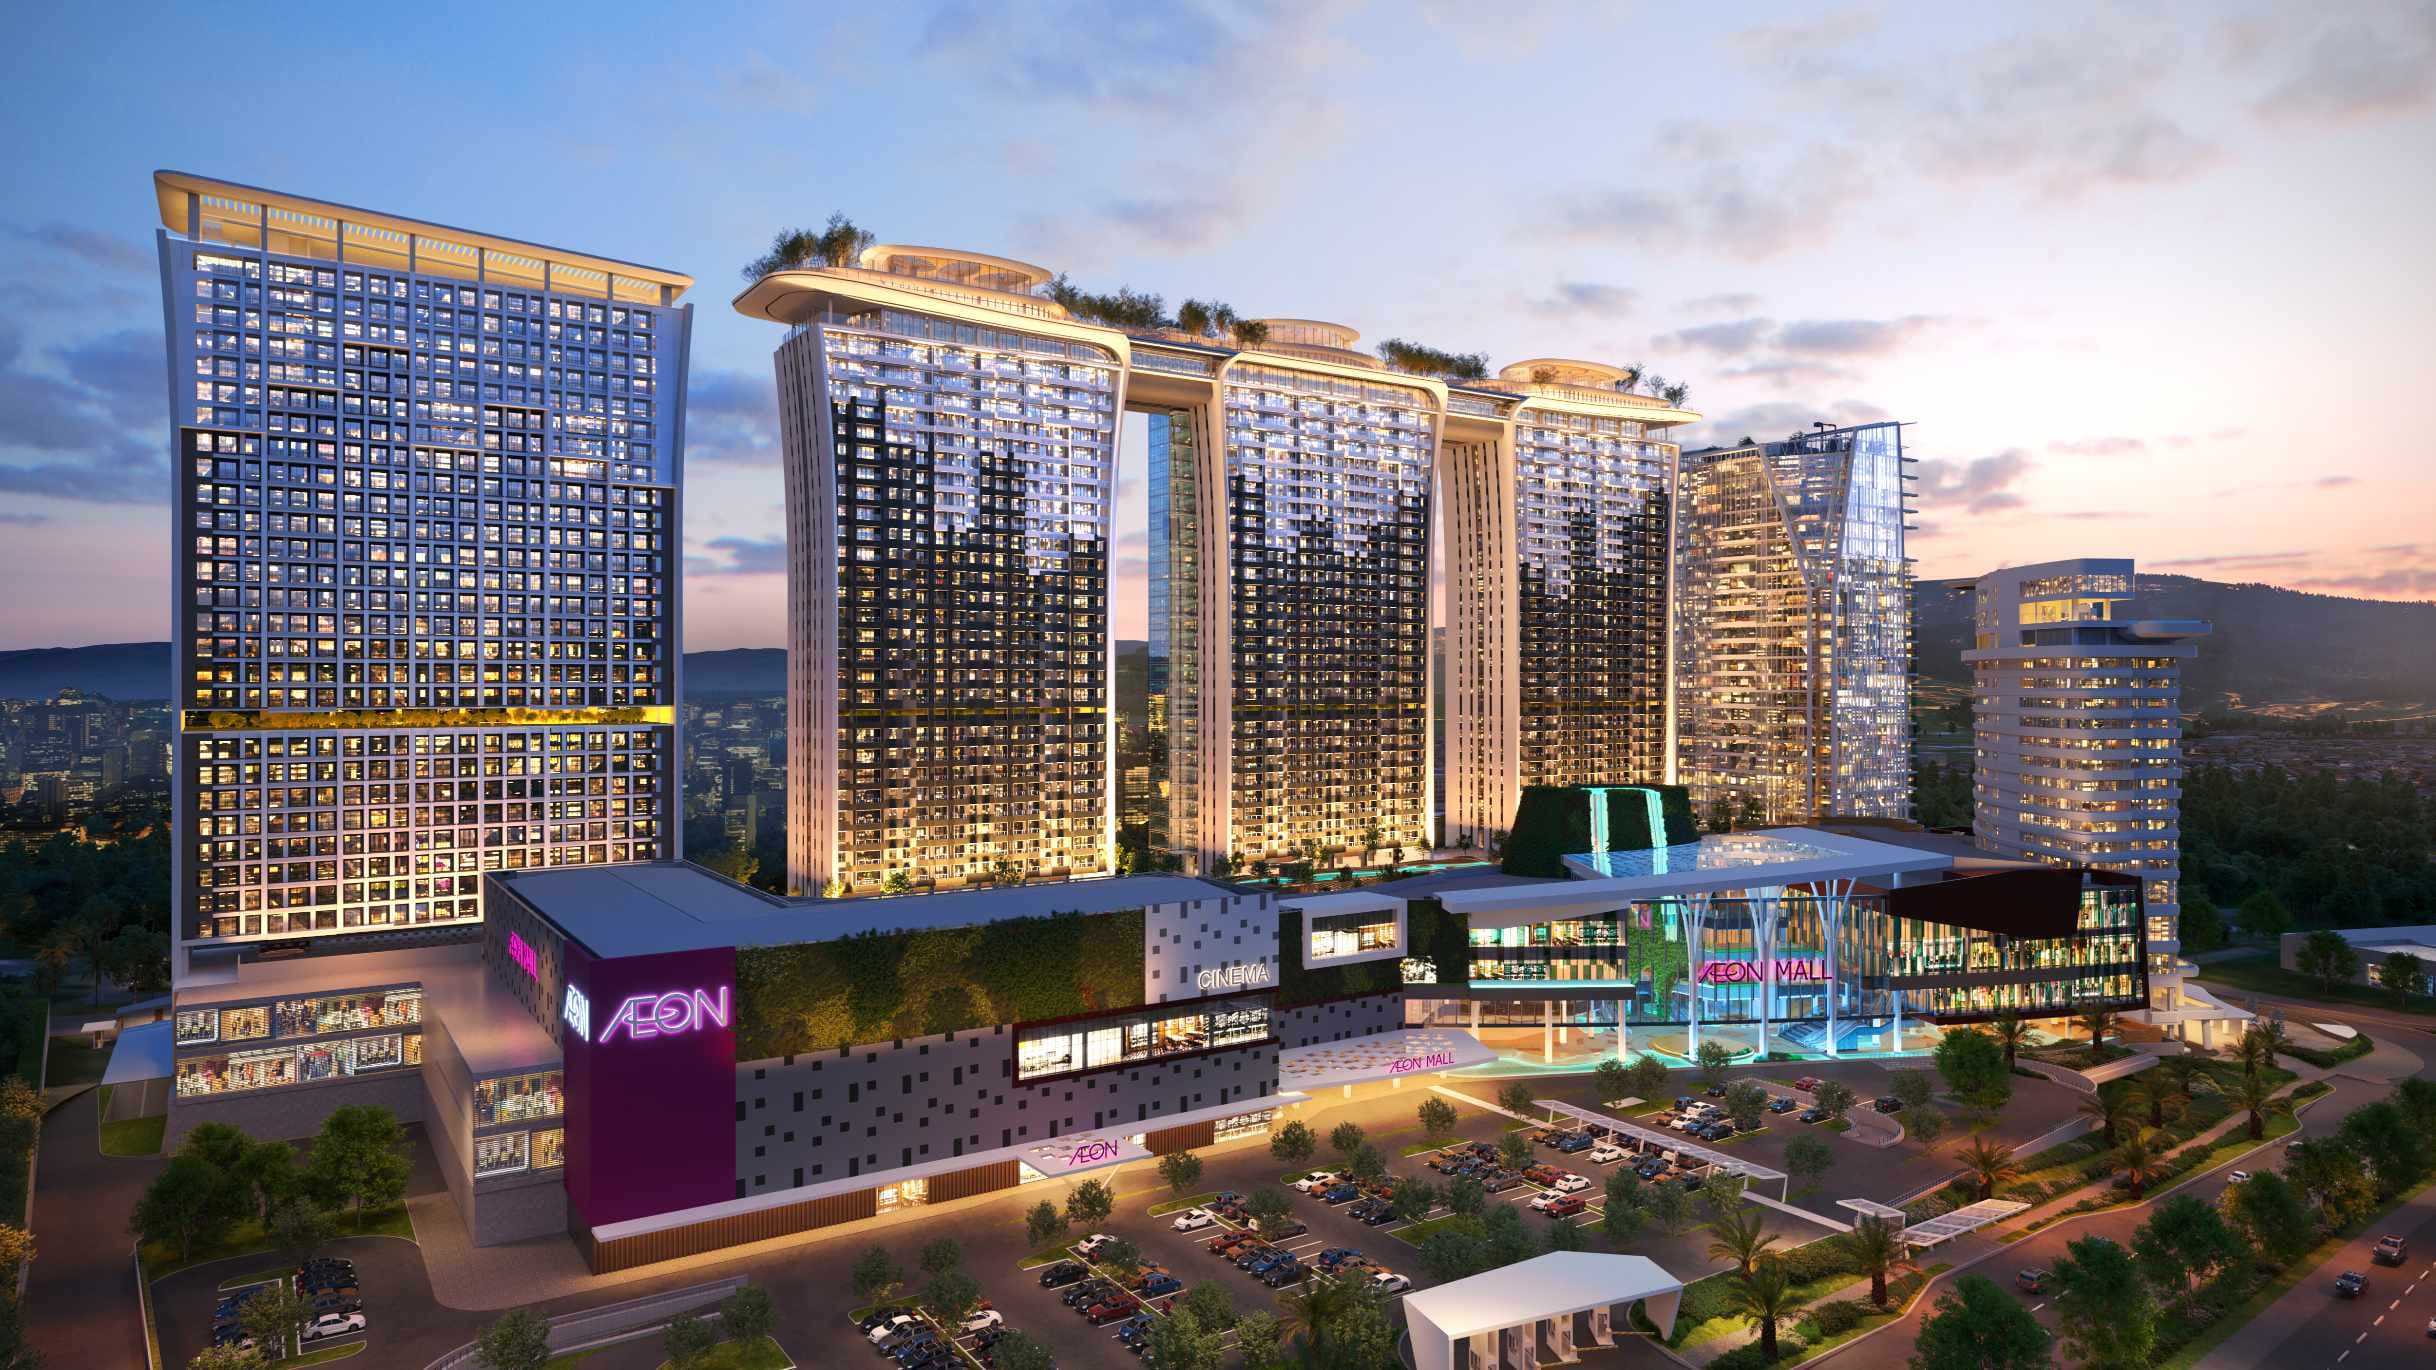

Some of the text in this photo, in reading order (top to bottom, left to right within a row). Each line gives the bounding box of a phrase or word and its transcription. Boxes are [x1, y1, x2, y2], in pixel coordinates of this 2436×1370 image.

[1198, 963, 1269, 990] CINEMA
[1775, 959, 1833, 982] MALL
[1426, 1051, 1455, 1067] MALL
